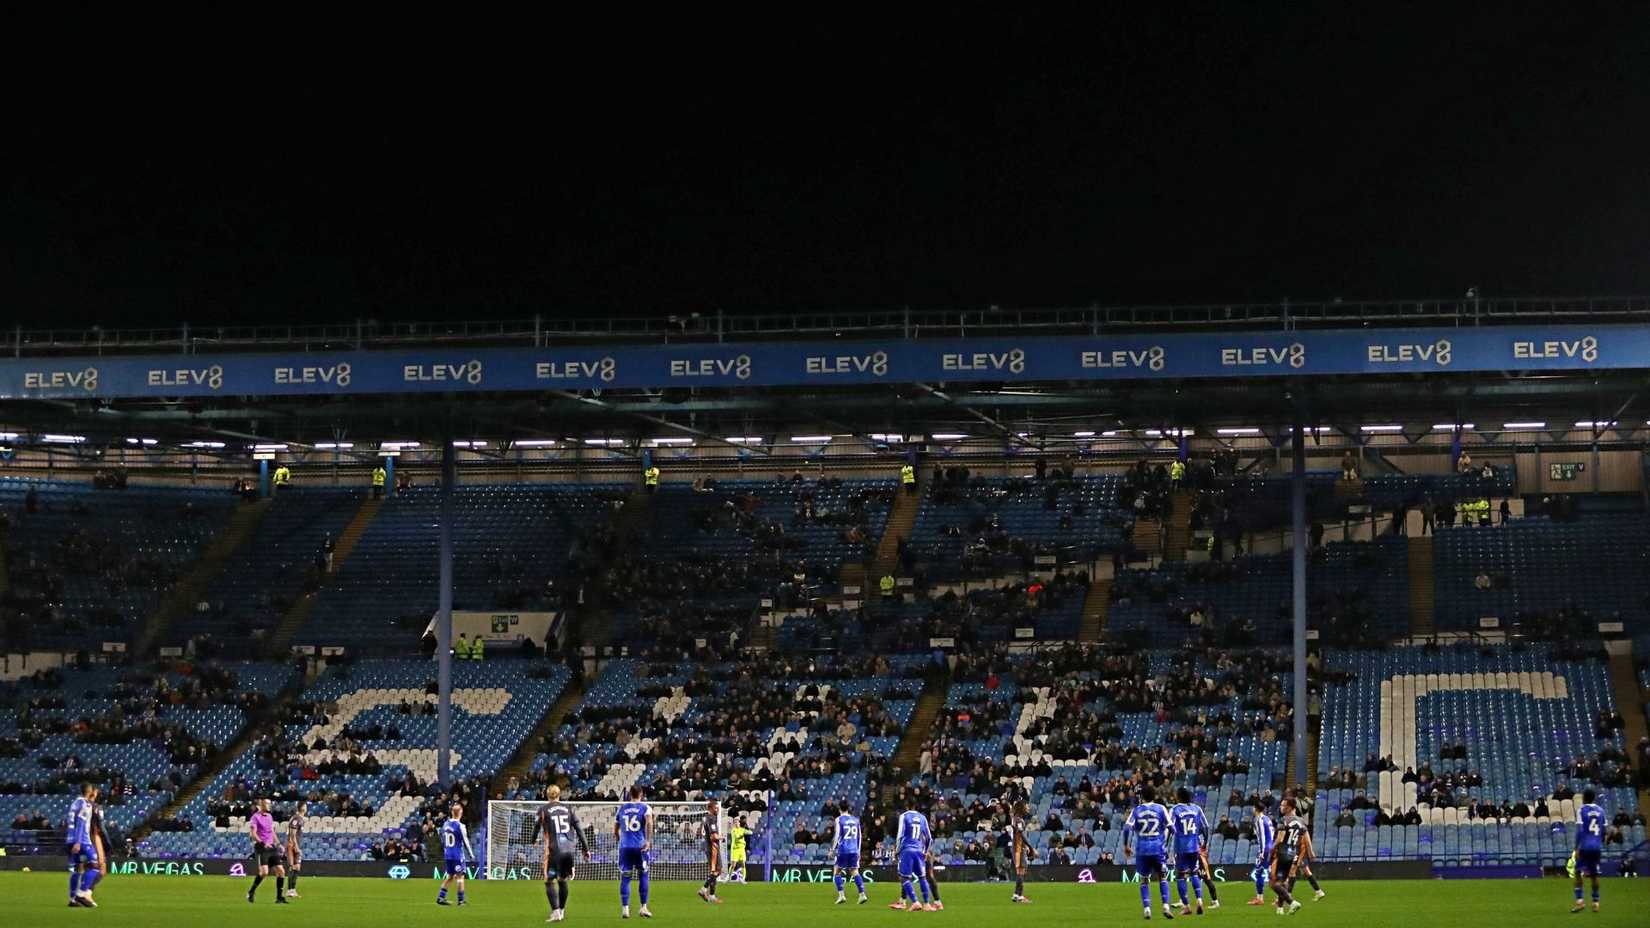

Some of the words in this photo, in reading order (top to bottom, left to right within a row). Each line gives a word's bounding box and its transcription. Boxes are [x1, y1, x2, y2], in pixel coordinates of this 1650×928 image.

[551, 815, 570, 834] 15
[623, 814, 641, 833] 16
[843, 825, 858, 840] 29
[911, 823, 921, 840] 11
[1137, 818, 1160, 836] 22
[1180, 817, 1197, 836] 14
[1588, 818, 1601, 836] 4
[444, 831, 456, 848] 10
[142, 861, 204, 876] VEGAS
